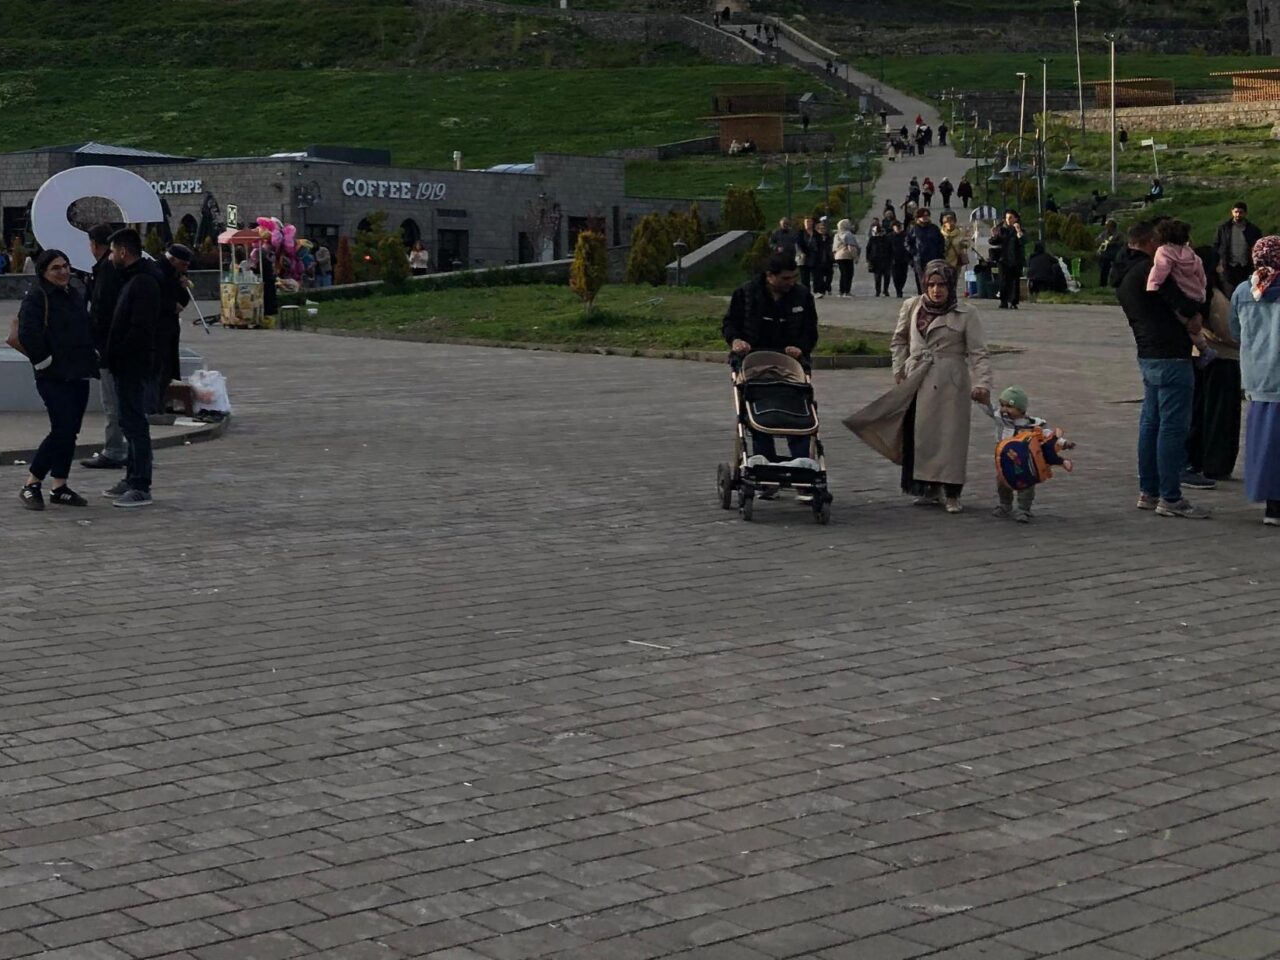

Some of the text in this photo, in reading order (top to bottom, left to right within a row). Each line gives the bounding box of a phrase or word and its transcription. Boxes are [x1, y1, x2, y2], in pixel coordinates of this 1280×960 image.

[149, 179, 202, 194] OCATEPE
[342, 178, 446, 201] COFFEE 1919
